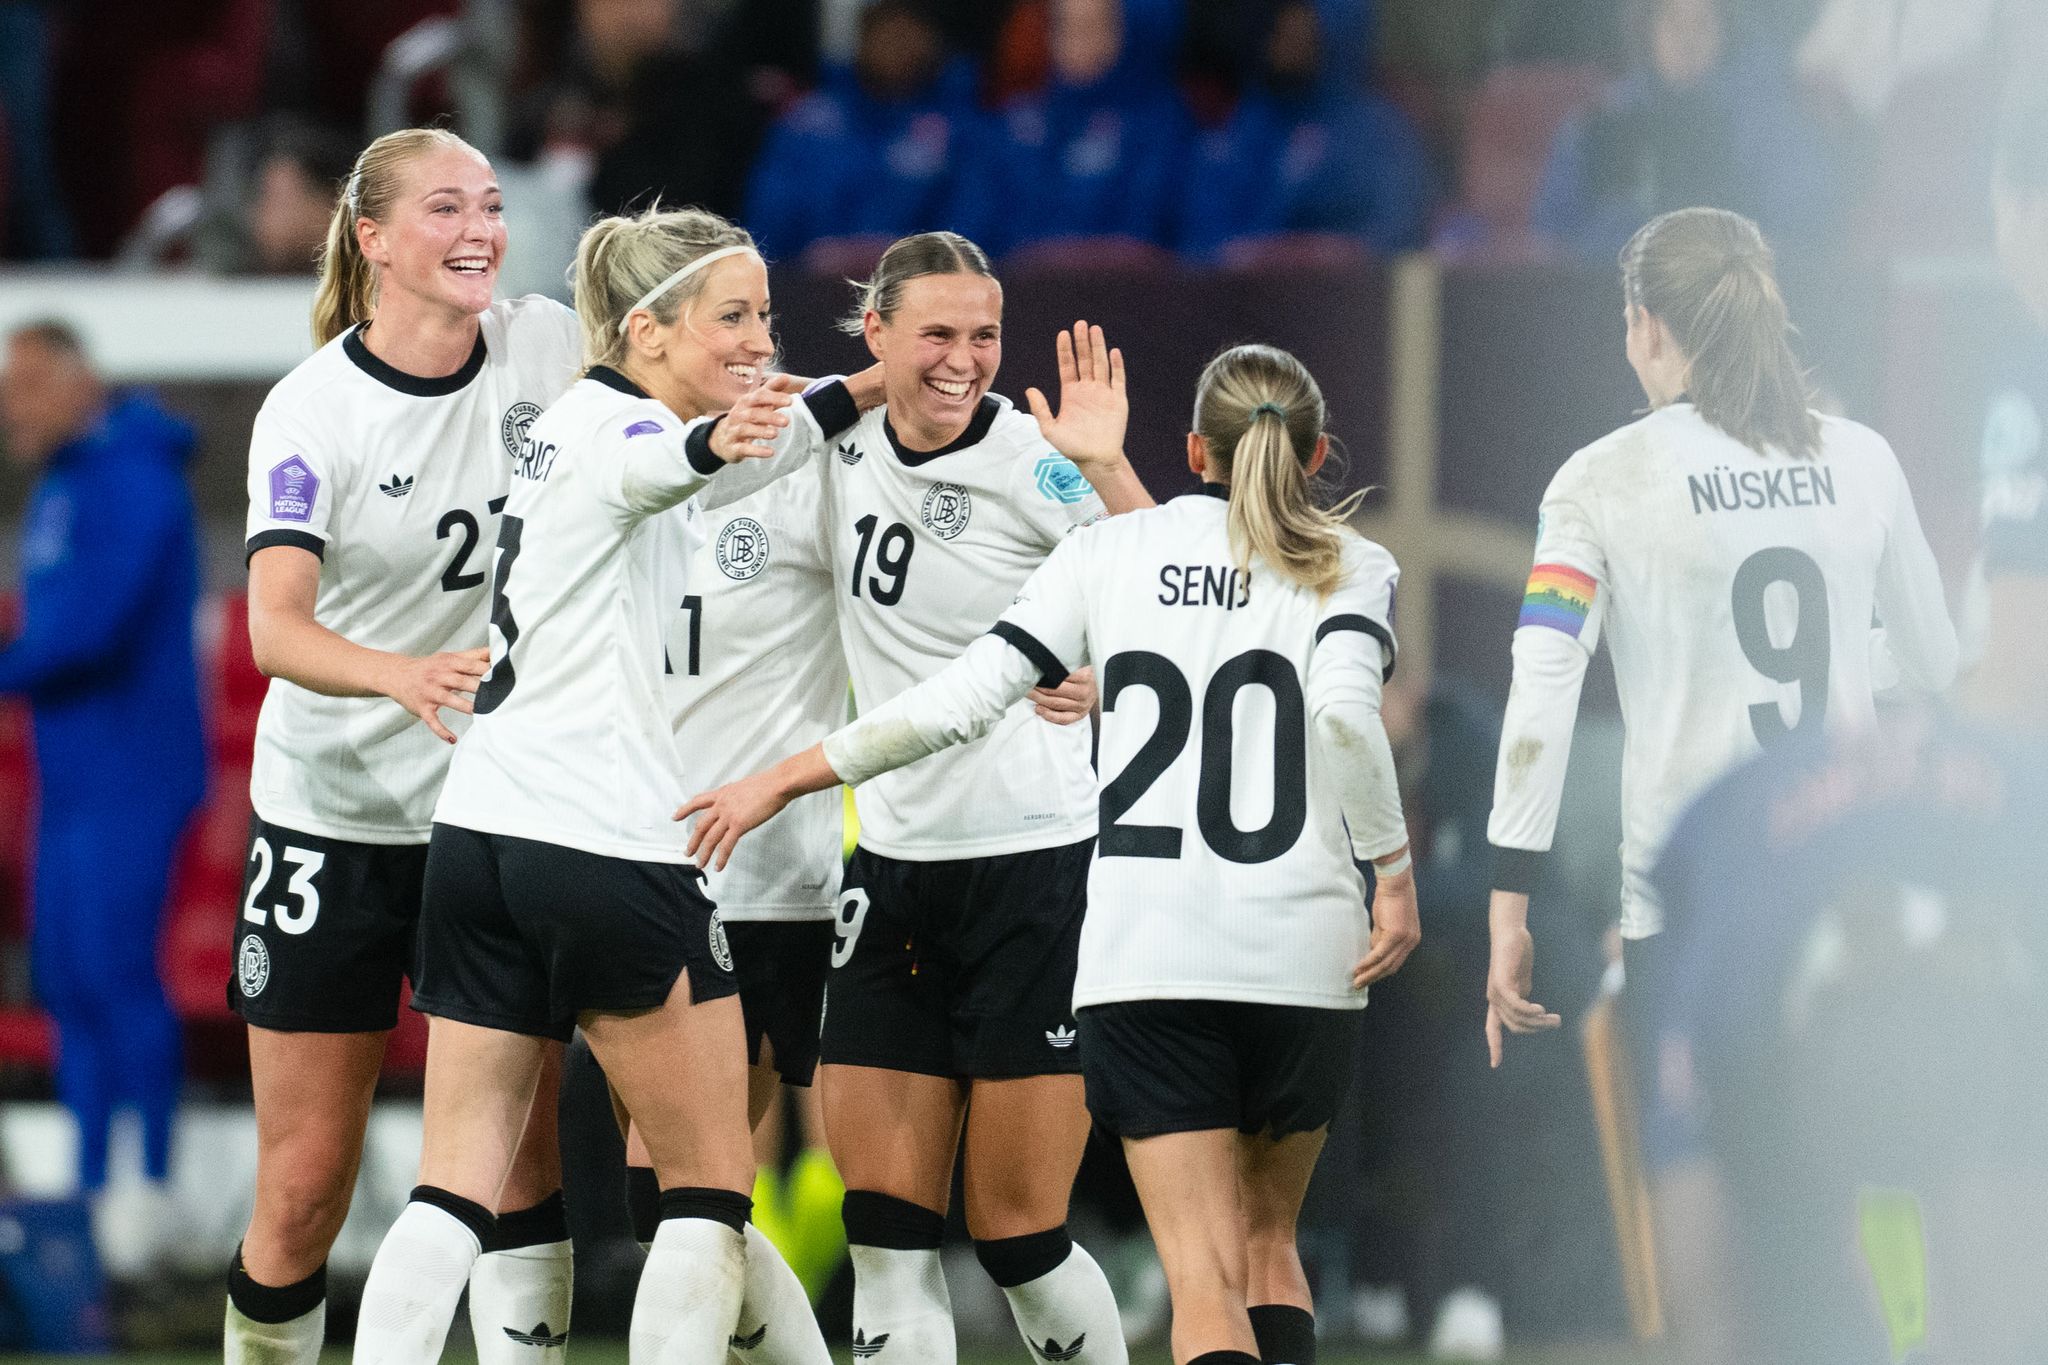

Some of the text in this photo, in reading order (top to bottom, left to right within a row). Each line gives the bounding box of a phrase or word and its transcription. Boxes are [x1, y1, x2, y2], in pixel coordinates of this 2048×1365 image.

[274, 500, 308, 509] NATIONS
[275, 506, 306, 515] LEAGUE
[1687, 466, 1836, 514] NÜSKEN
[852, 513, 914, 606] 19
[1731, 546, 1830, 757] 9
[1098, 649, 1307, 864] 20
[244, 837, 325, 935] 23
